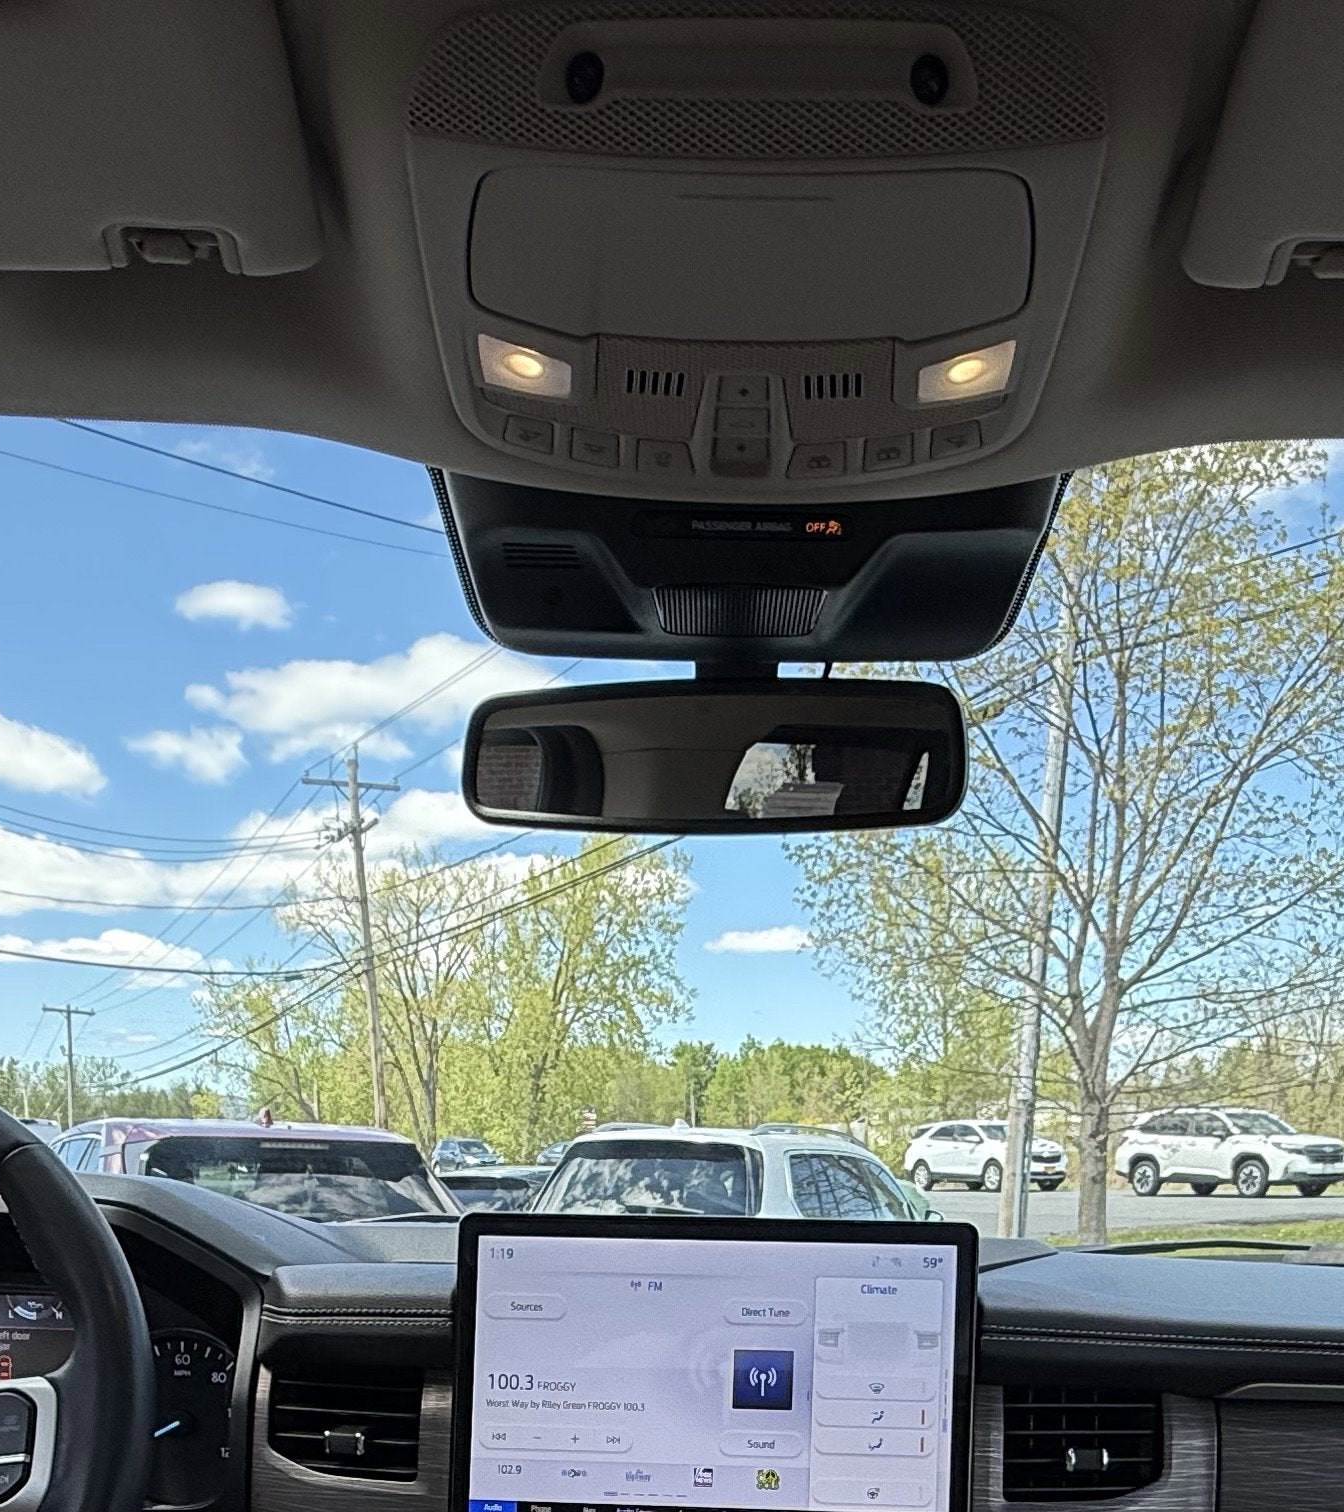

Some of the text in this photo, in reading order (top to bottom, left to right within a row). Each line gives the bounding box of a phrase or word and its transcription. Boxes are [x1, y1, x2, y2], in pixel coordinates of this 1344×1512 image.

[805, 522, 826, 533] OFF
[647, 1281, 663, 1292] FM
[860, 1284, 898, 1295] Climate
[510, 1302, 543, 1312] Sources
[741, 1307, 790, 1318] Direct Tune
[12, 1332, 31, 1340] door
[174, 1354, 191, 1365] 60
[174, 1369, 191, 1377] MPH
[211, 1372, 227, 1383] 80
[488, 1373, 576, 1392] 100.3 FROGGY
[486, 1399, 645, 1412] Worst Way by Riley Green FROGGY 100.3
[746, 1438, 776, 1450] Sound
[497, 1464, 522, 1475] 102.9
[484, 1503, 503, 1512] Audio
[530, 1505, 552, 1512] Phone
